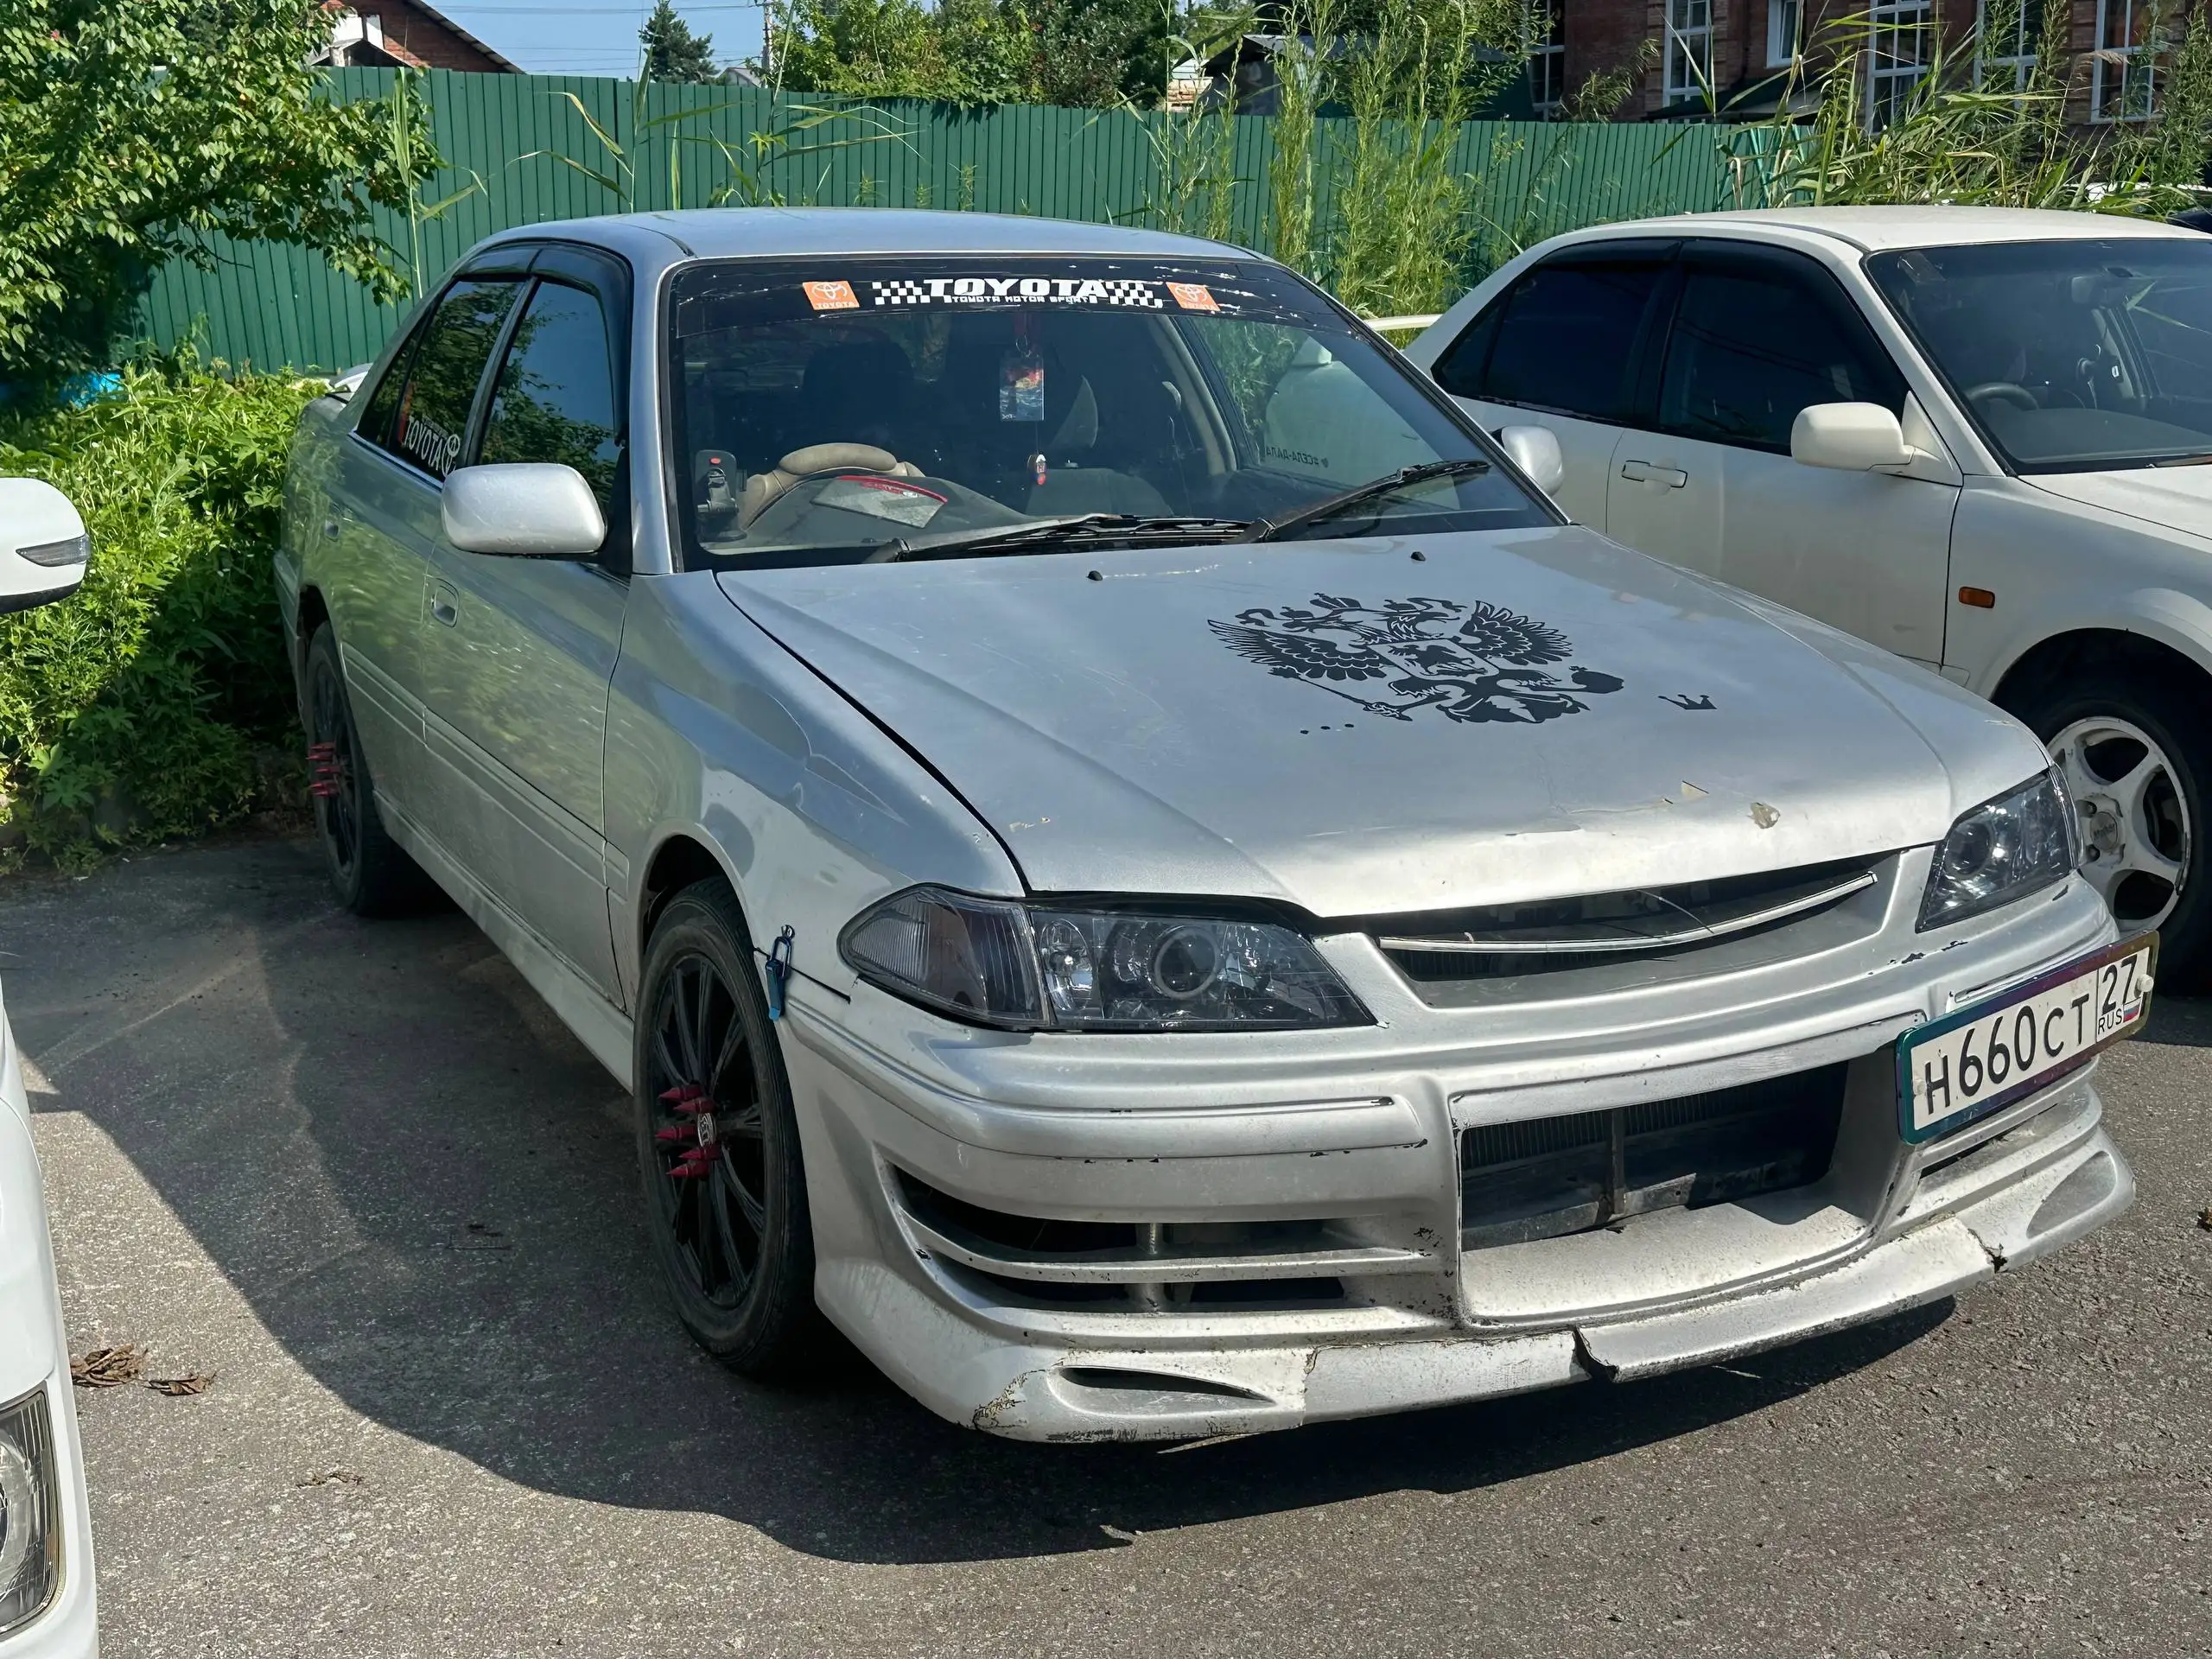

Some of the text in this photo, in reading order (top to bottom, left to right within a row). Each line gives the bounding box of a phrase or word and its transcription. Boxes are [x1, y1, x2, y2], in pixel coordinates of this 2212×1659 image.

[923, 278, 1111, 298] TOYOTA
[952, 295, 1001, 303] TOYOTA
[1005, 295, 1046, 303] MOTOR
[816, 301, 858, 309] TOYOTA
[404, 416, 442, 471] TOYOTA
[2101, 954, 2138, 1014] 27
[2098, 1008, 2122, 1035] RUS
